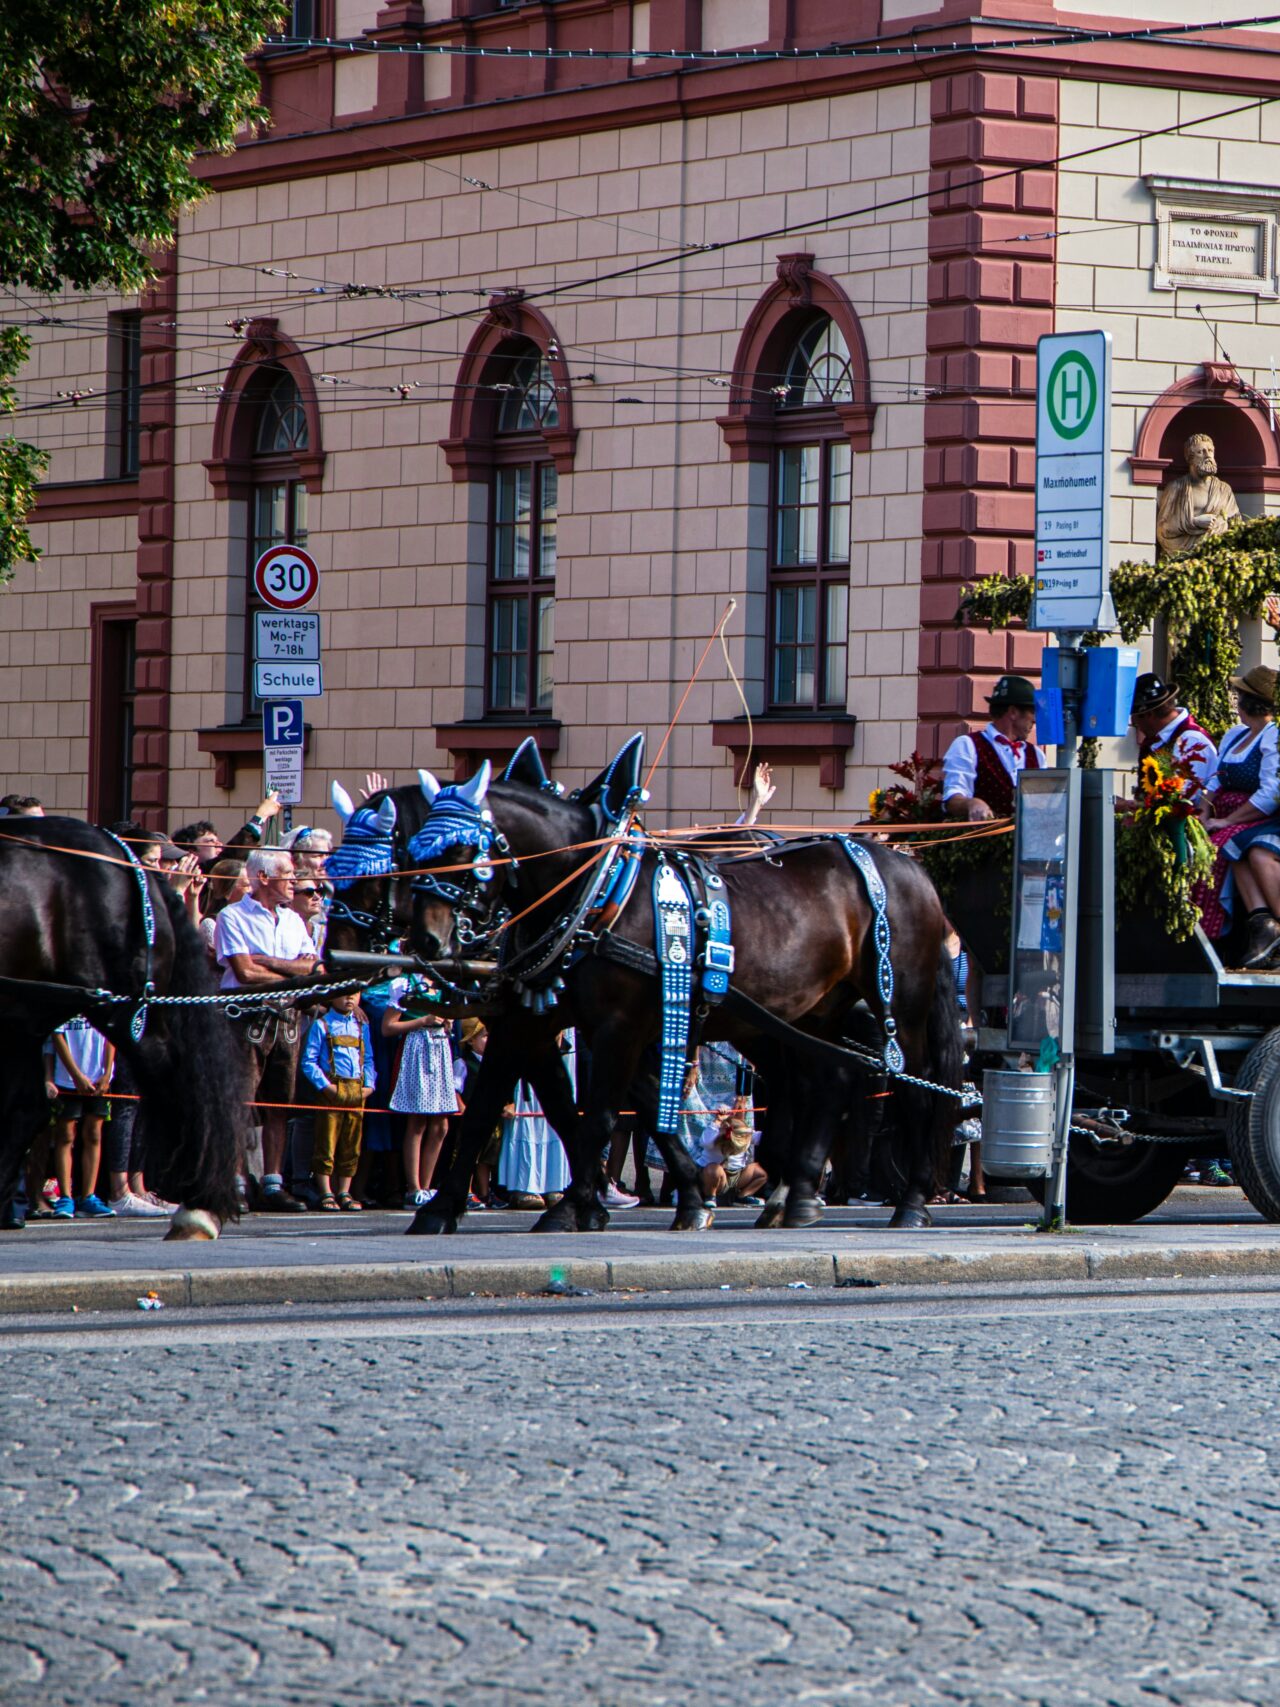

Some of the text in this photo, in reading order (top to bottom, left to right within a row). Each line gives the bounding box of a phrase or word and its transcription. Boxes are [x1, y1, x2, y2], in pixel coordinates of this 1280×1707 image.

[1190, 227, 1239, 239] ΤΟ ΦΡΟΝΕΙΝ
[1061, 369, 1082, 421] H
[1043, 476, 1097, 489] Maxmonument
[1044, 520, 1052, 531] 19
[1056, 521, 1073, 531] Pasing
[1044, 549, 1052, 560] 21
[1056, 549, 1088, 559] Westfriedhof
[269, 563, 306, 592] 30
[261, 618, 316, 631] werktags
[270, 631, 306, 642] Mo-Fr
[274, 644, 304, 655] 7-18h
[263, 673, 315, 687] Schule
[273, 706, 294, 741] P
